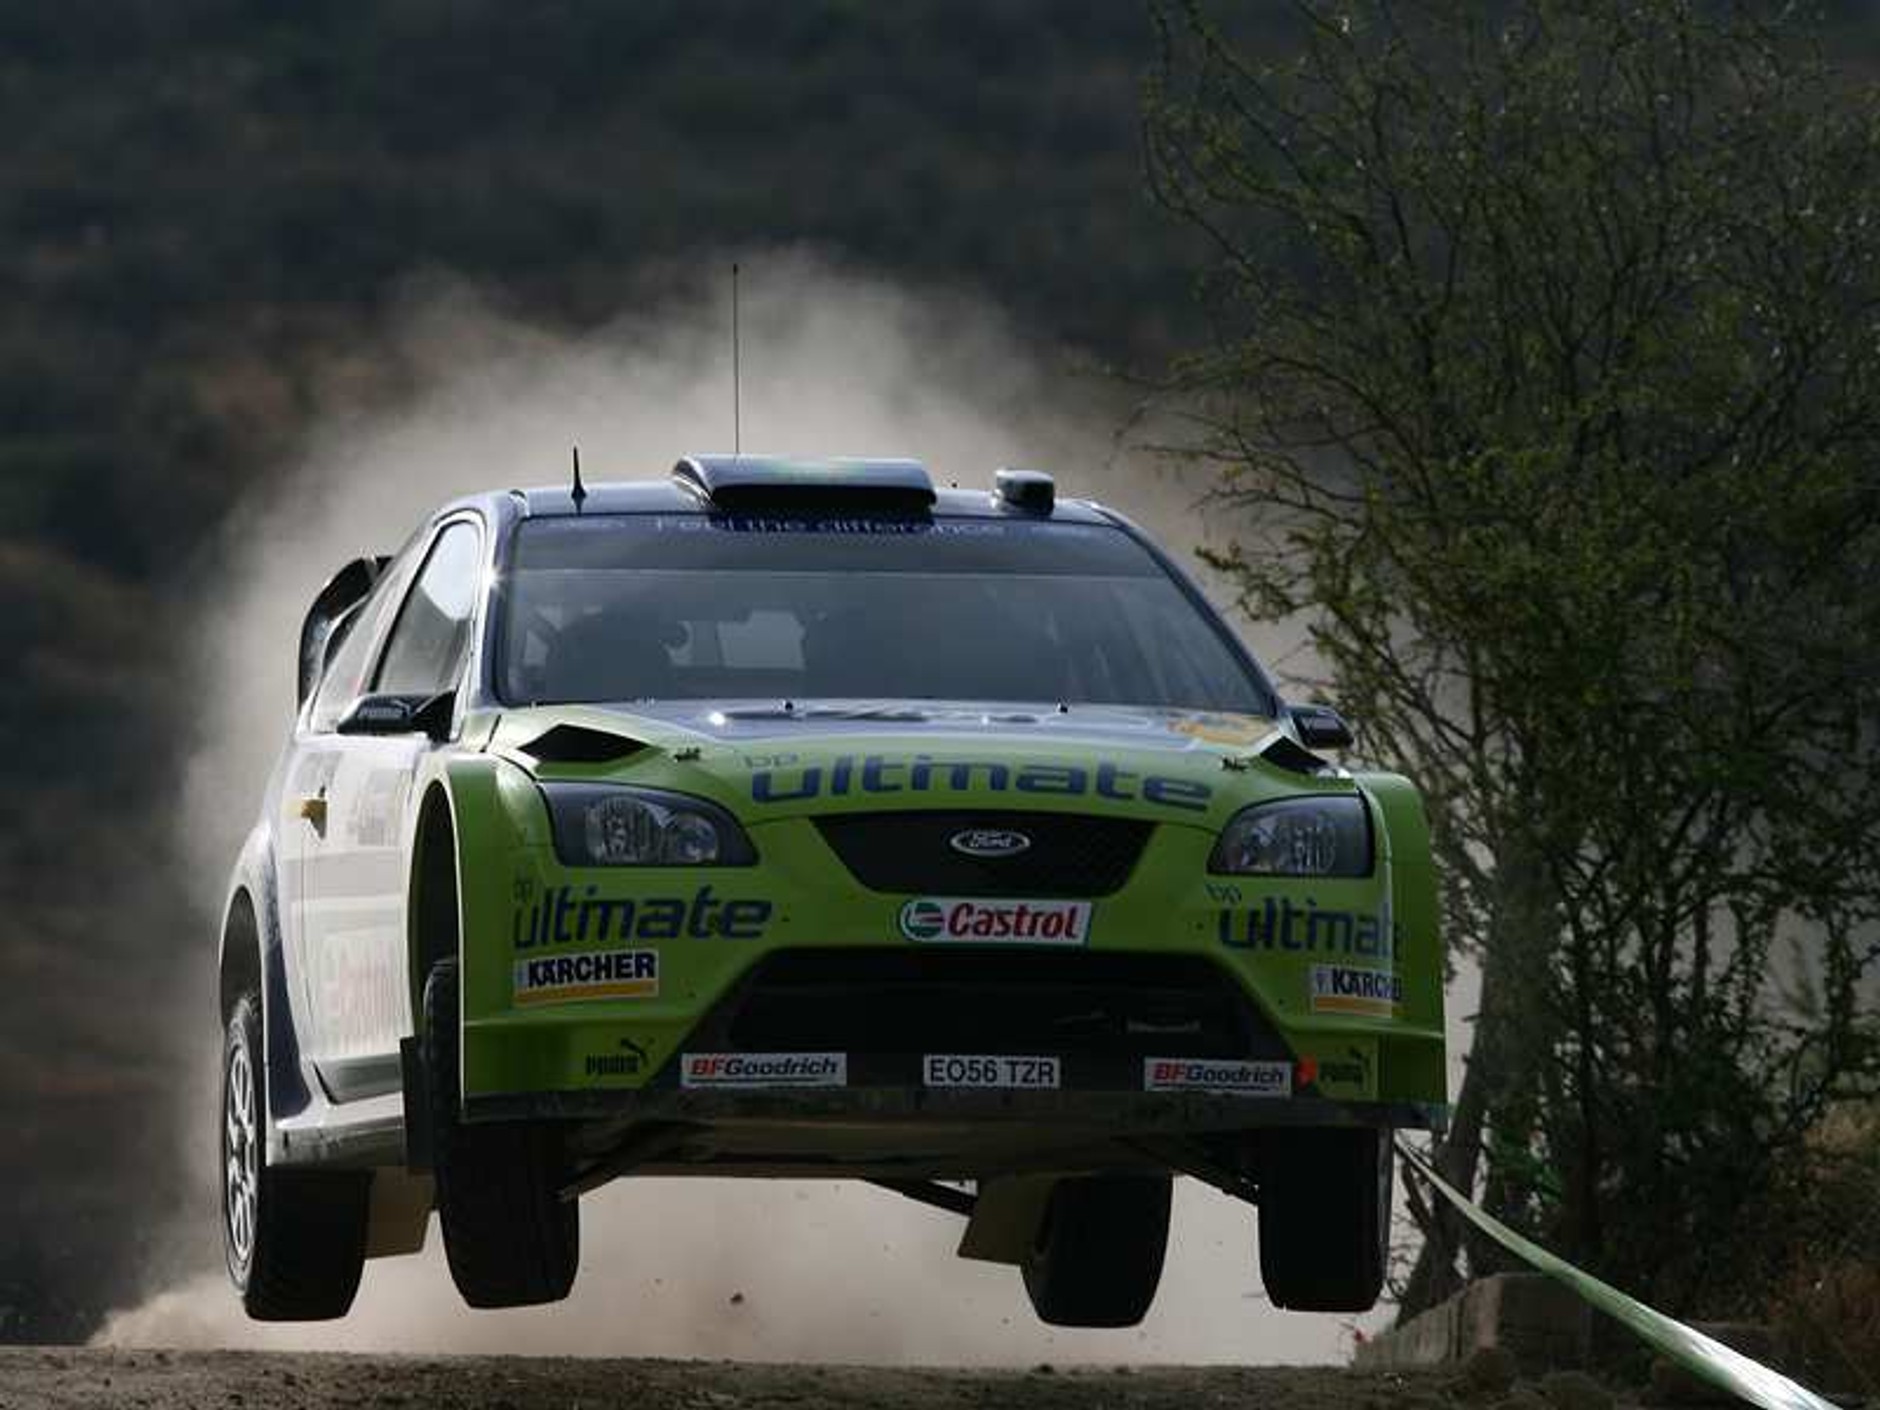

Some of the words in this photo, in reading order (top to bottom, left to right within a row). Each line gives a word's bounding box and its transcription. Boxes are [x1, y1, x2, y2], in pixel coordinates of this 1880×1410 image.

[751, 754, 1213, 814] ultimate
[513, 883, 773, 949] ultimate
[949, 902, 1080, 940] Castrol
[689, 1056, 838, 1077] BFGoodrich
[930, 1058, 997, 1084] EO56
[1003, 1059, 1055, 1085] TZR
[1153, 1061, 1284, 1085] BFGoodrich
